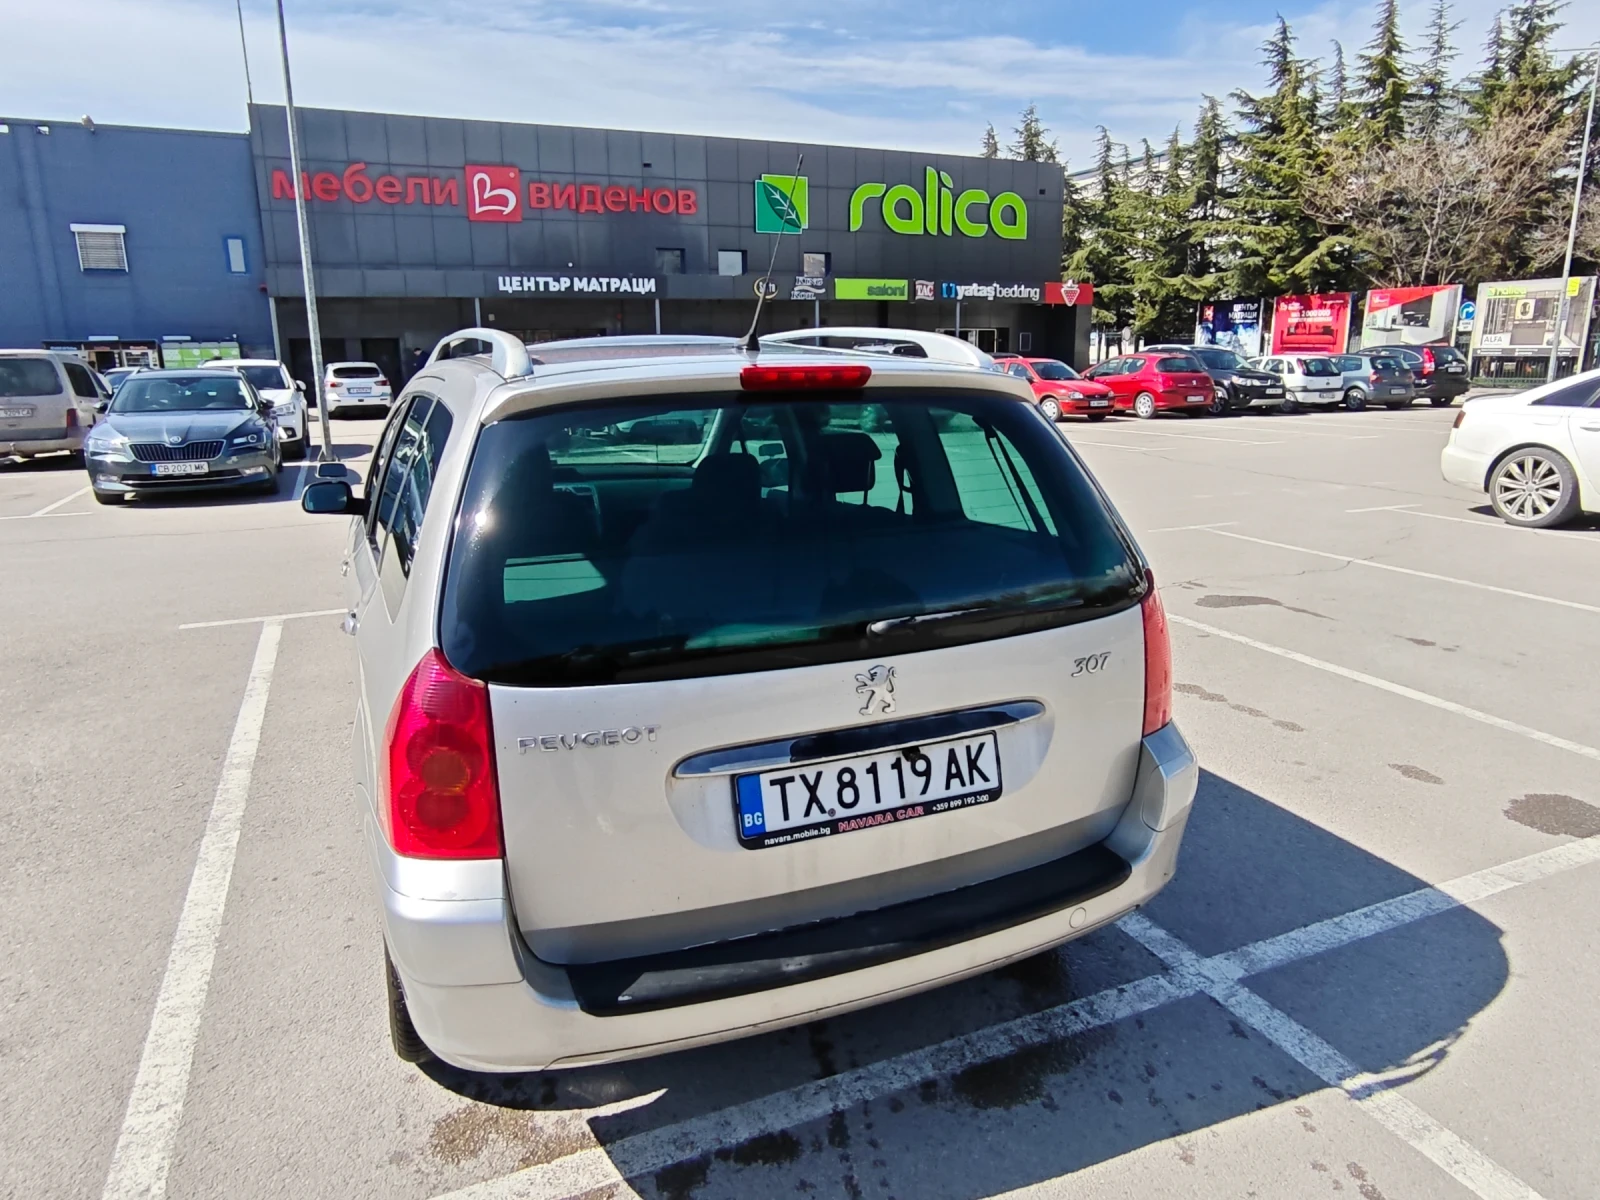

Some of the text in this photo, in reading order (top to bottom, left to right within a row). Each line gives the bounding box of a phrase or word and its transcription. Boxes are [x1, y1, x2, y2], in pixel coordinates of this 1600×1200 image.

[272, 162, 697, 215] мебели виденов
[850, 165, 1028, 240] ralica
[498, 276, 657, 295] ЦЕНТЪР МАТРАЦИ
[867, 283, 906, 297] saloni
[996, 283, 1040, 301] bedding
[157, 464, 170, 474] CB
[171, 463, 193, 474] 2021
[1070, 651, 1112, 678] 307
[516, 724, 662, 755] PEUGEOT
[769, 741, 991, 822] TX 8119 AK
[743, 811, 763, 828] BG
[764, 826, 831, 847] navara.mobile.bg
[837, 811, 895, 833] NAVARA
[896, 805, 925, 819] CAR
[932, 801, 949, 812] +359
[949, 799, 962, 808] 899
[963, 796, 976, 805] 192
